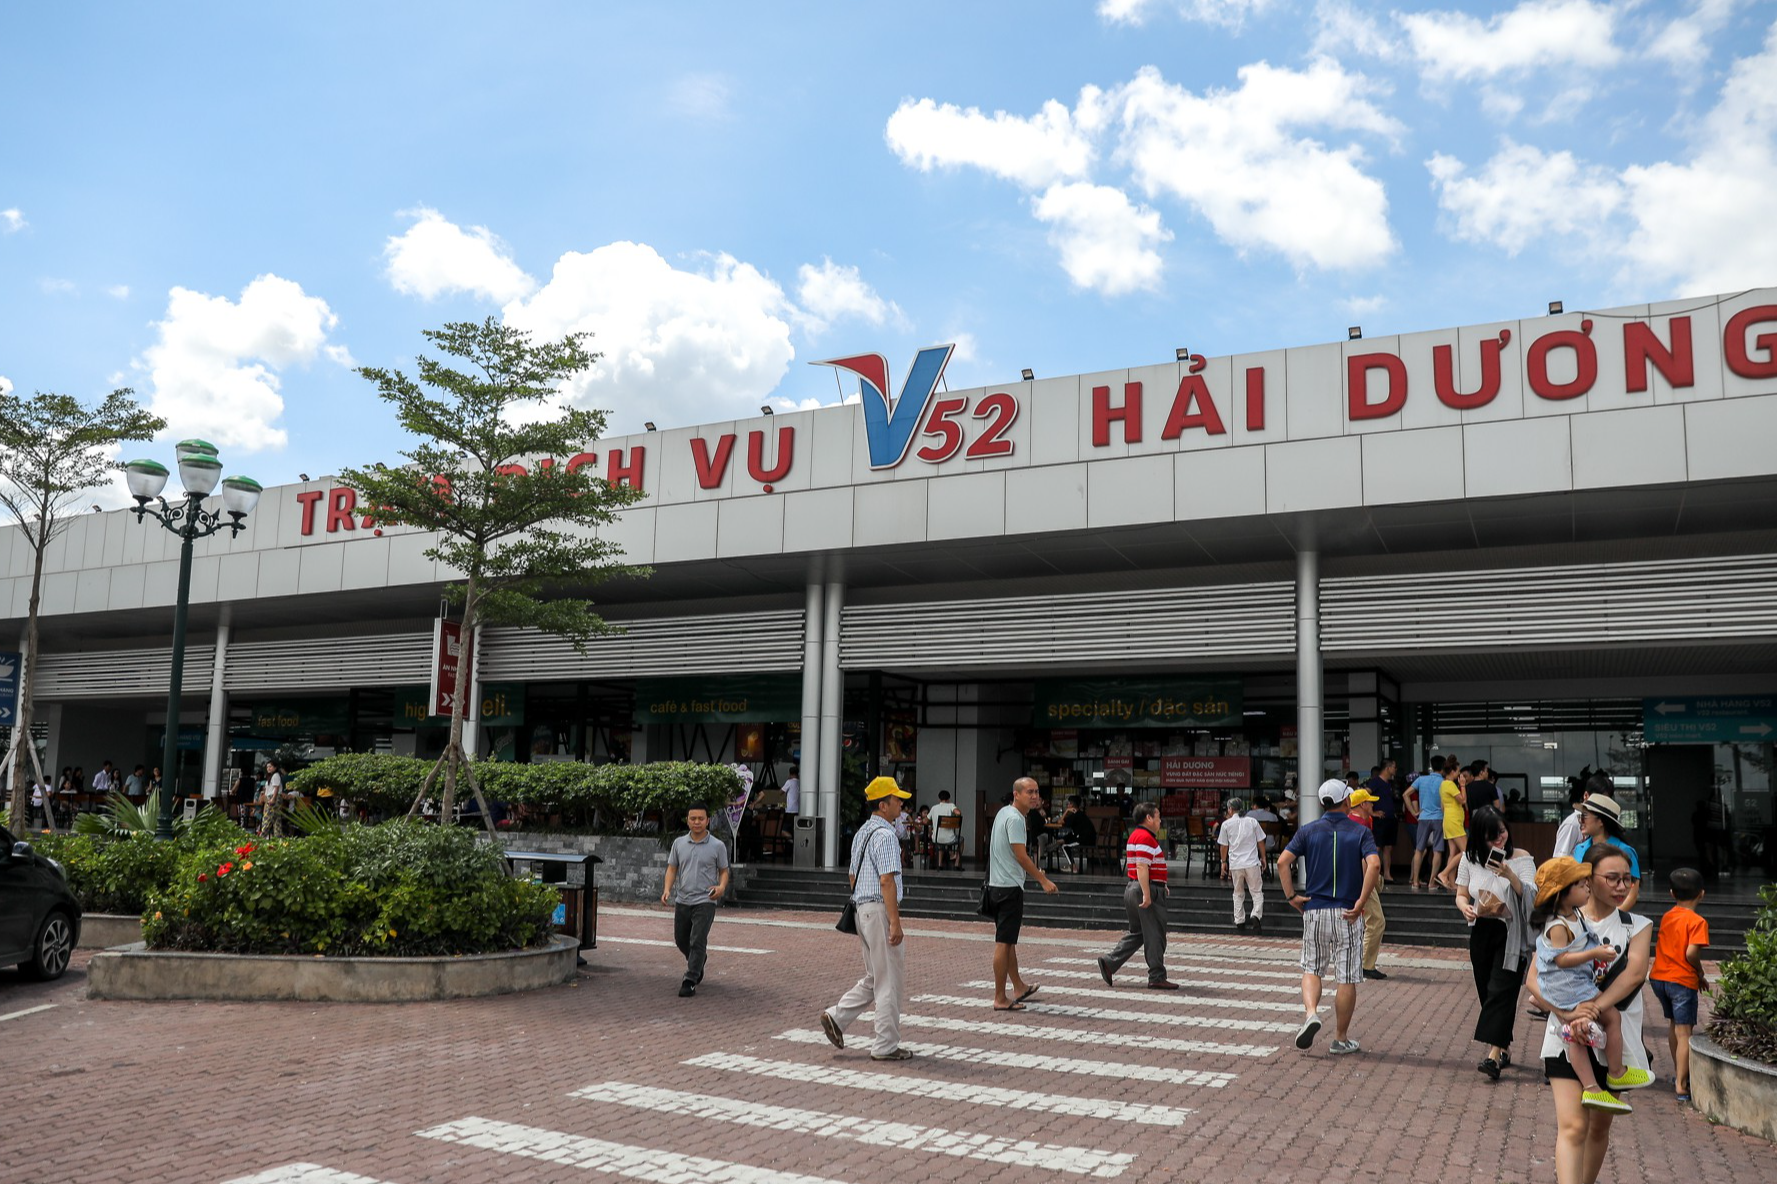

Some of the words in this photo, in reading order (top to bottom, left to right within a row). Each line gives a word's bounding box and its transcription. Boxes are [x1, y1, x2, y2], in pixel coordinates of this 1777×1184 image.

[689, 426, 795, 493] VỤ
[808, 343, 1019, 470] V52
[1092, 354, 1265, 447] HẢI
[1347, 305, 1777, 421] DƯƠNG
[481, 693, 512, 717] eli.
[650, 699, 678, 713] café
[680, 702, 688, 713] &
[690, 699, 715, 713] fast
[718, 698, 747, 713] food
[1048, 699, 1134, 720] specialty
[1138, 699, 1146, 716] /
[1150, 697, 1188, 720] đặc
[1193, 695, 1230, 716] sản
[1752, 699, 1773, 707] V52
[257, 714, 277, 728] fast
[277, 714, 299, 728] food
[1698, 722, 1717, 731] V52
[1166, 759, 1180, 769] HẢI
[1183, 761, 1214, 769] DƯƠNG
